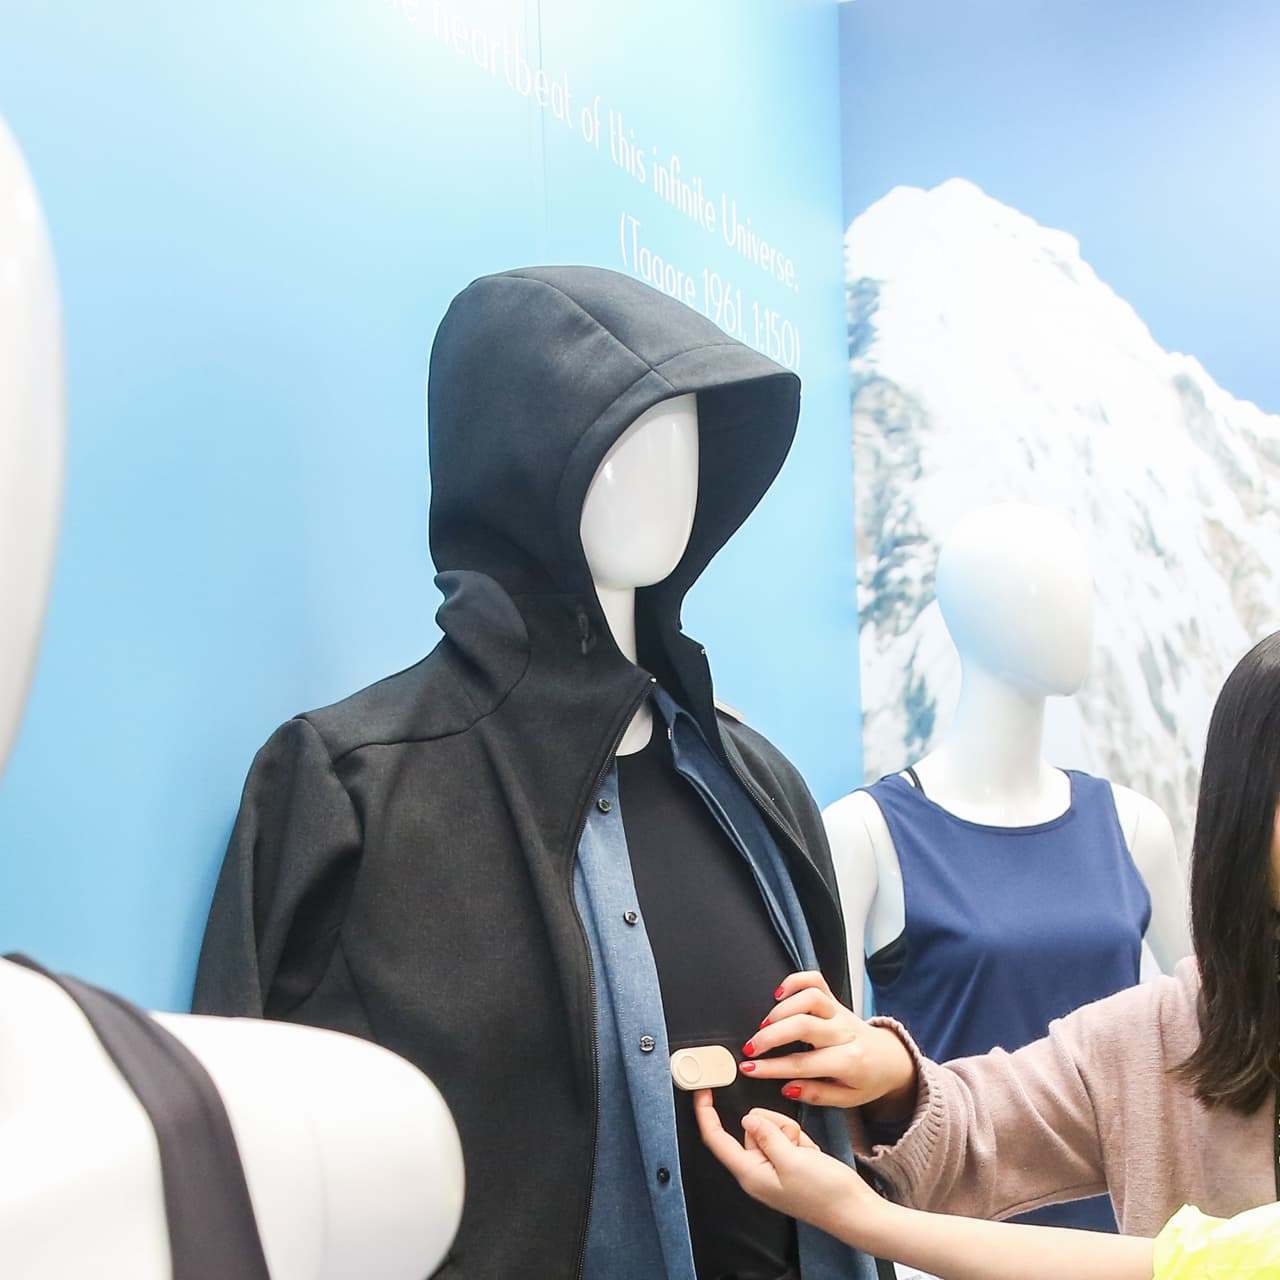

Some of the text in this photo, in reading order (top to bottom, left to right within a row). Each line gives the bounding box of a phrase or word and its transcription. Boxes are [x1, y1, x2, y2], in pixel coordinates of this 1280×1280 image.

[432, 1, 800, 293] heartbeat of this infinite Universe.
[619, 210, 696, 306] (Tagore
